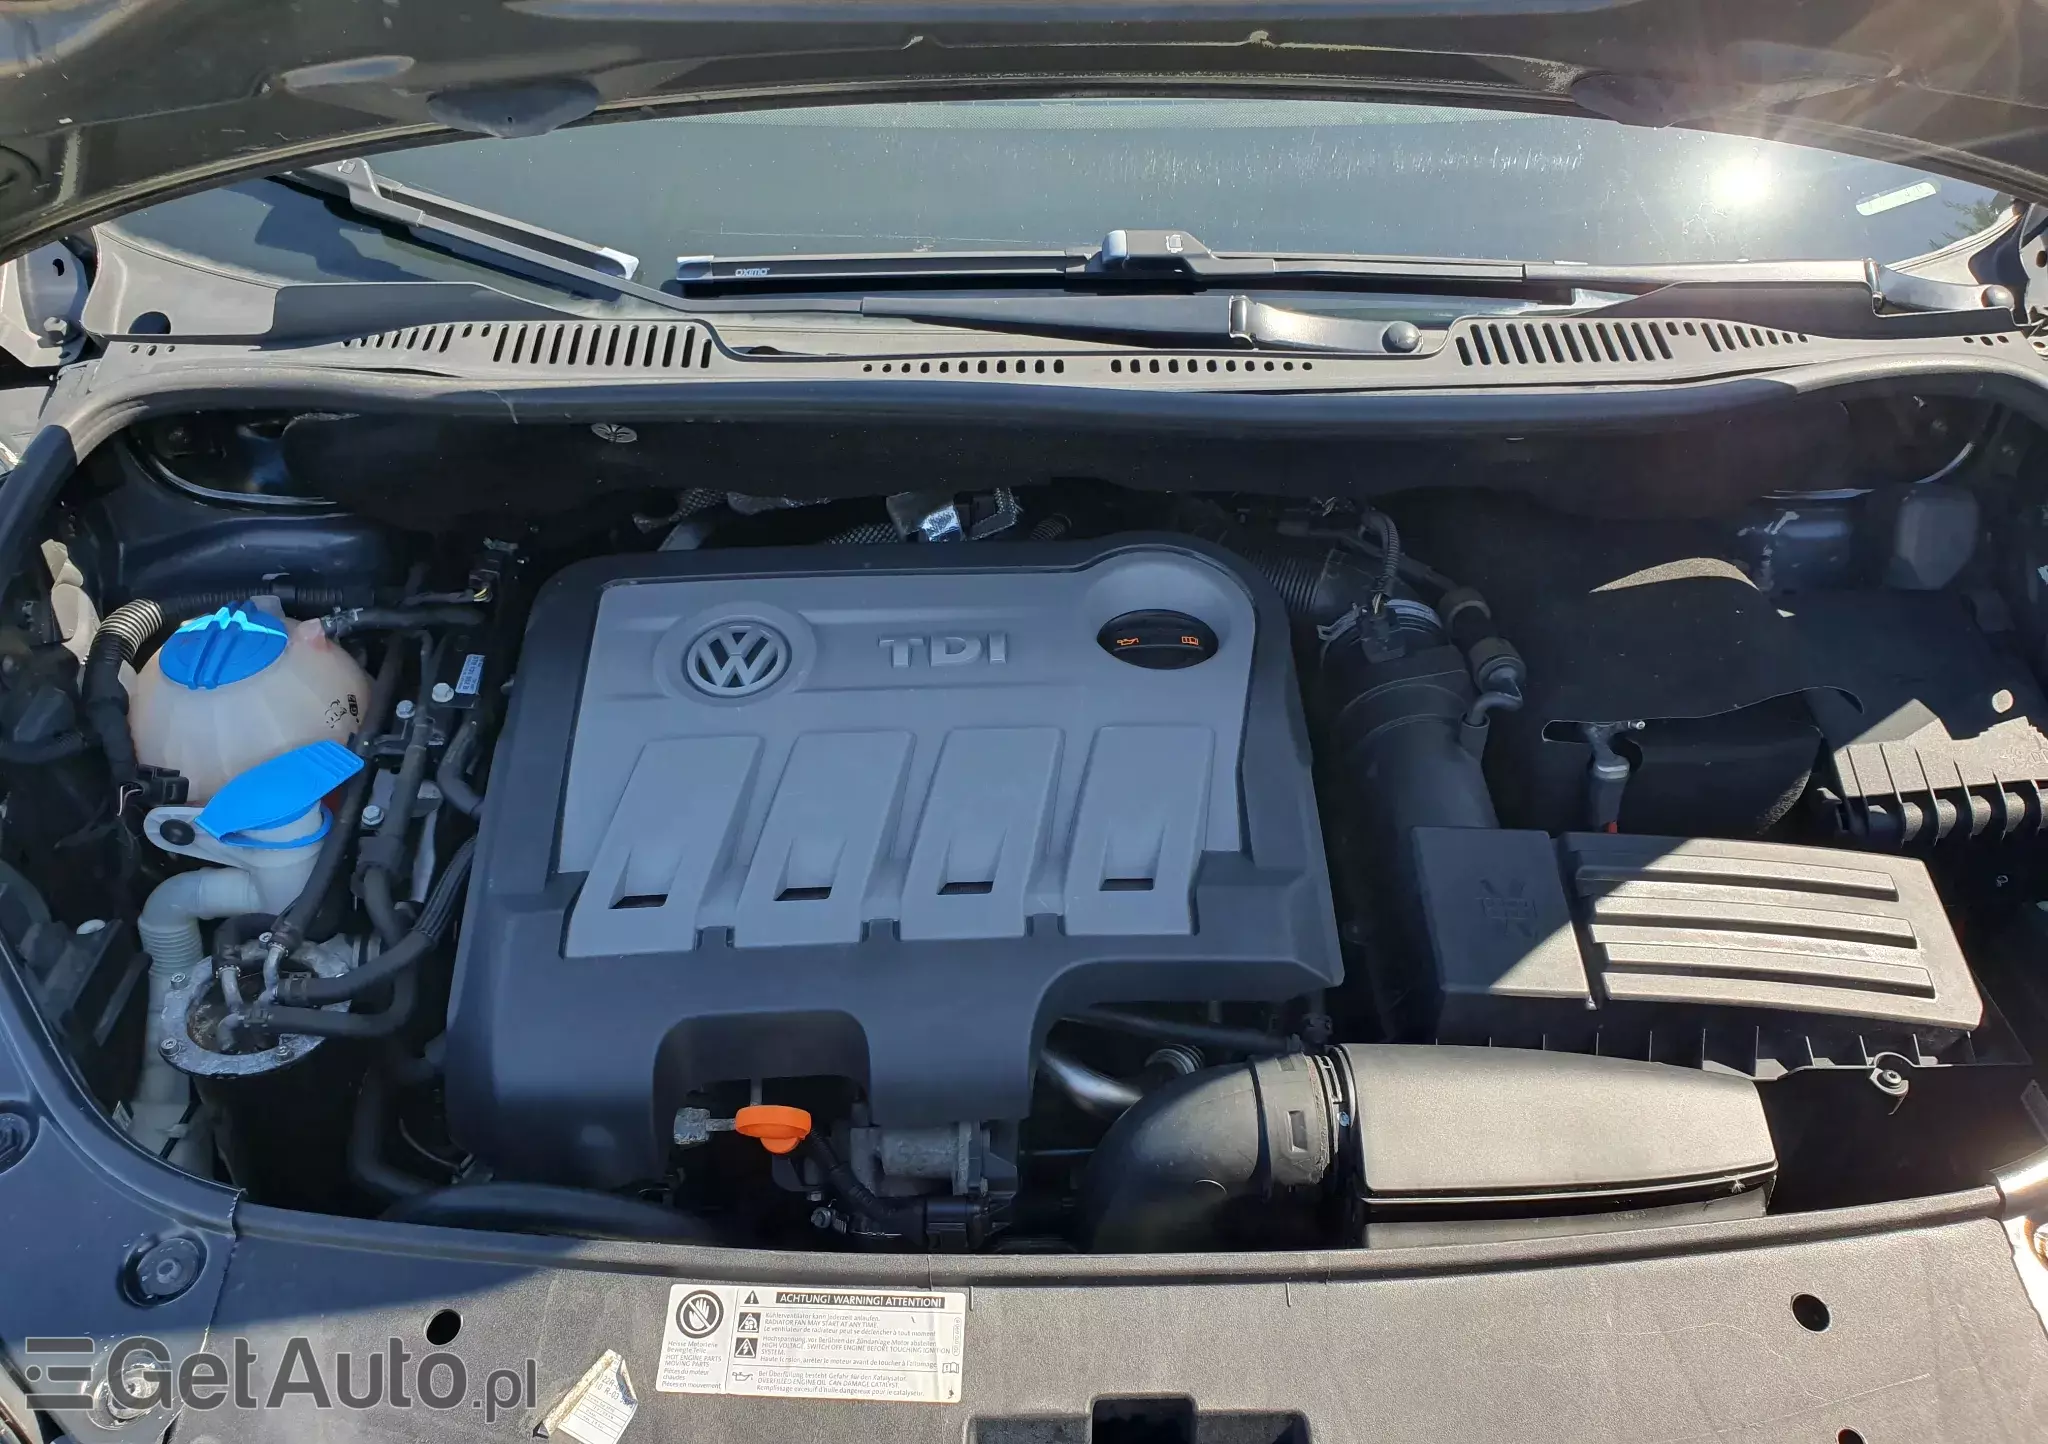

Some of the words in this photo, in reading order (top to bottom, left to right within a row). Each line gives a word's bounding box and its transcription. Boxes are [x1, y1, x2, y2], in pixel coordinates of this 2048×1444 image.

[687, 617, 789, 697] VW
[878, 634, 1007, 668] TDI
[780, 1293, 831, 1304] ACHTUNG!
[833, 1295, 884, 1305] WARNING!
[885, 1296, 942, 1308] ATTENTION!
[688, 1381, 722, 1389] mouvement
